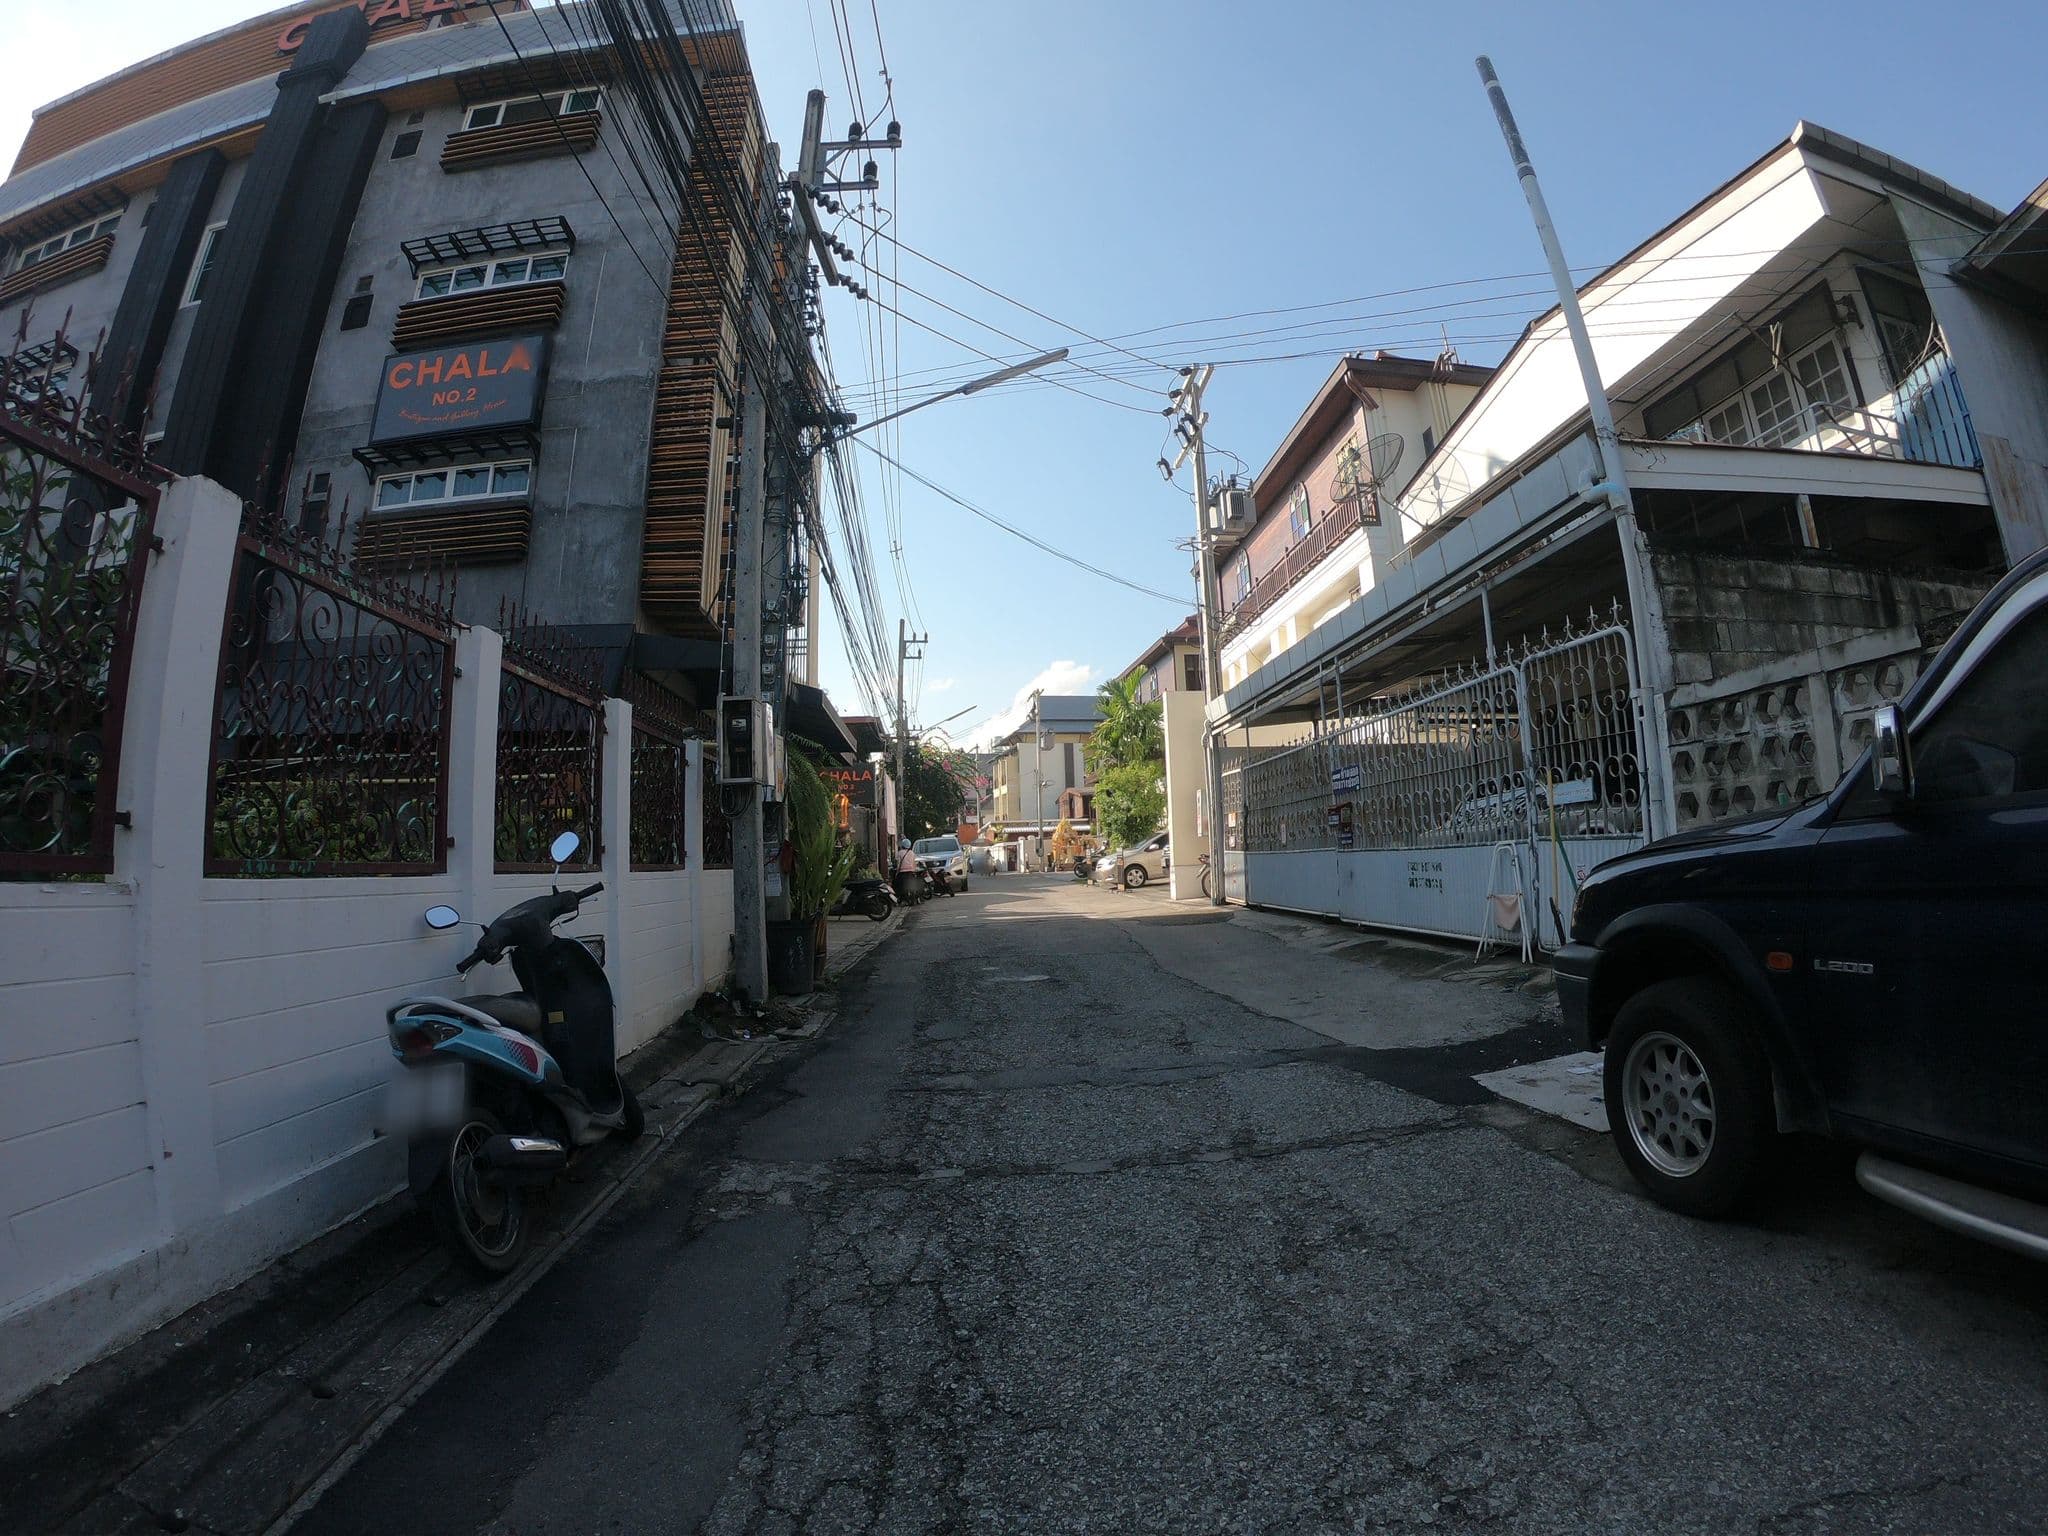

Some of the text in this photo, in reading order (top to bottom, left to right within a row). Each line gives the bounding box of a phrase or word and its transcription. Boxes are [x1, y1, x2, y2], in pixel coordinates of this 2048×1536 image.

[388, 343, 532, 390] CHALA
[432, 387, 477, 406] NO.2
[1814, 959, 1874, 974] L200
